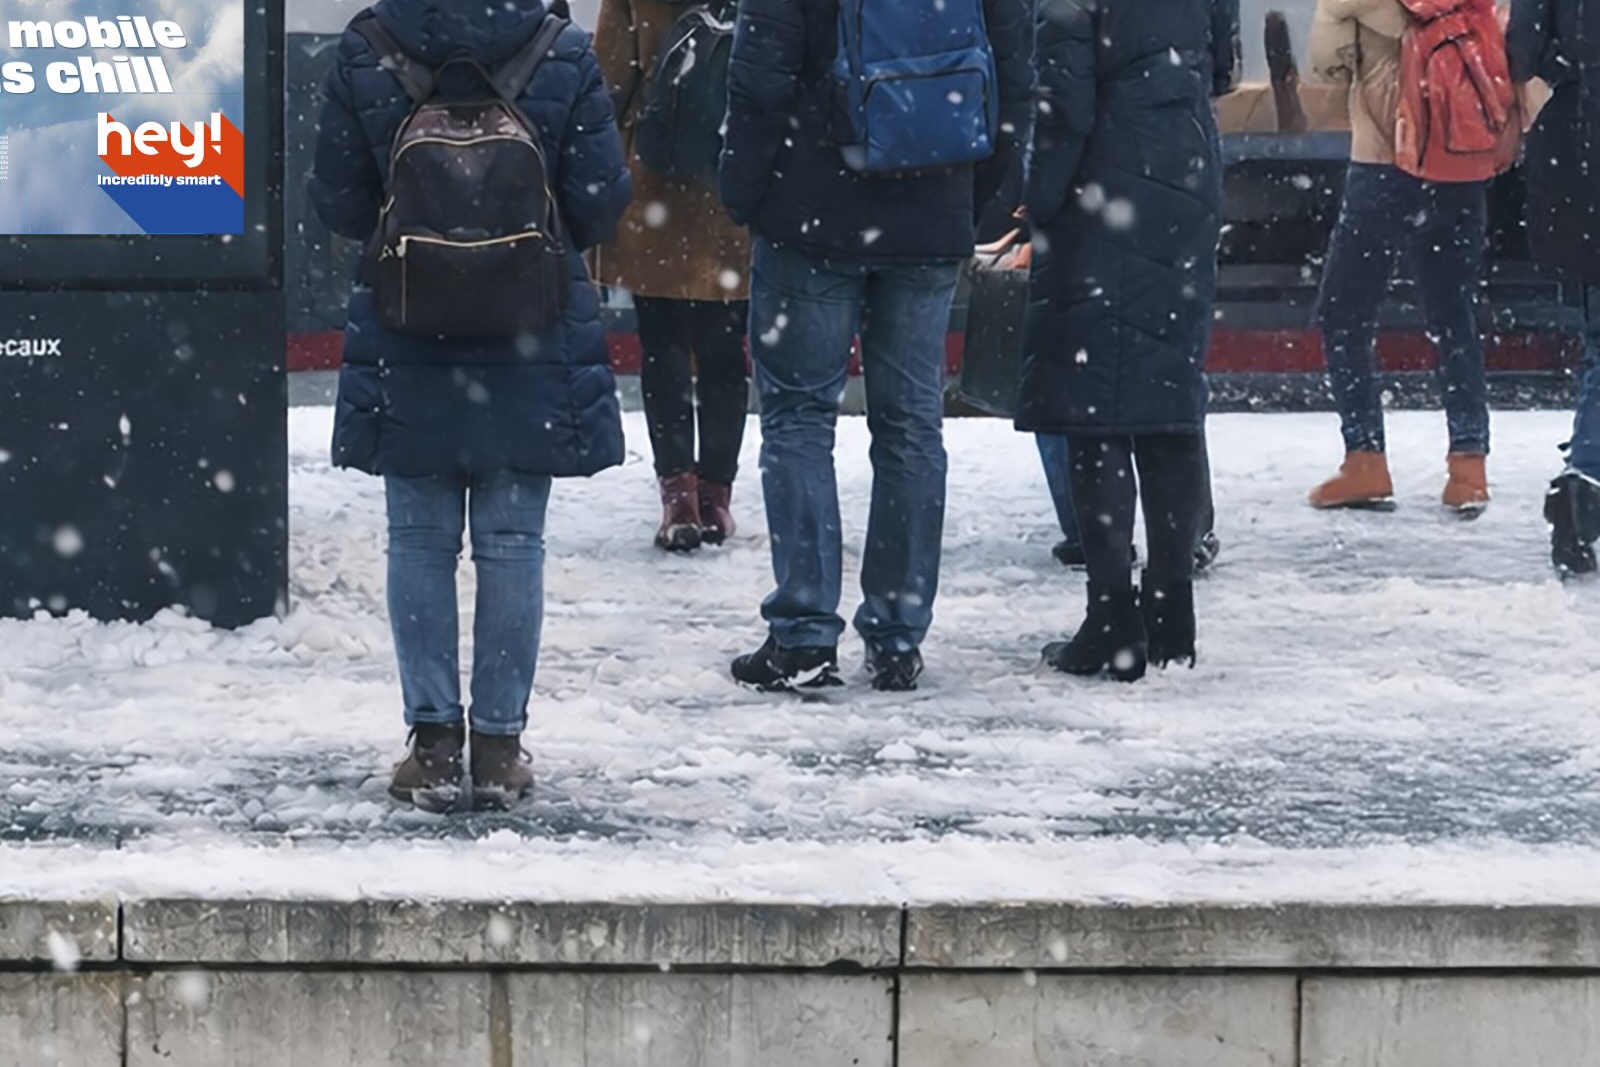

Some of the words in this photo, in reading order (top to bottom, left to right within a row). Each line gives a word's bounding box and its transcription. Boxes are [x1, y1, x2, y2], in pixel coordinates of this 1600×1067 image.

[8, 15, 187, 48] mobile
[45, 55, 174, 93] chill
[98, 112, 221, 168] hey!
[98, 175, 173, 186] Incredibly
[176, 176, 221, 185] smart
